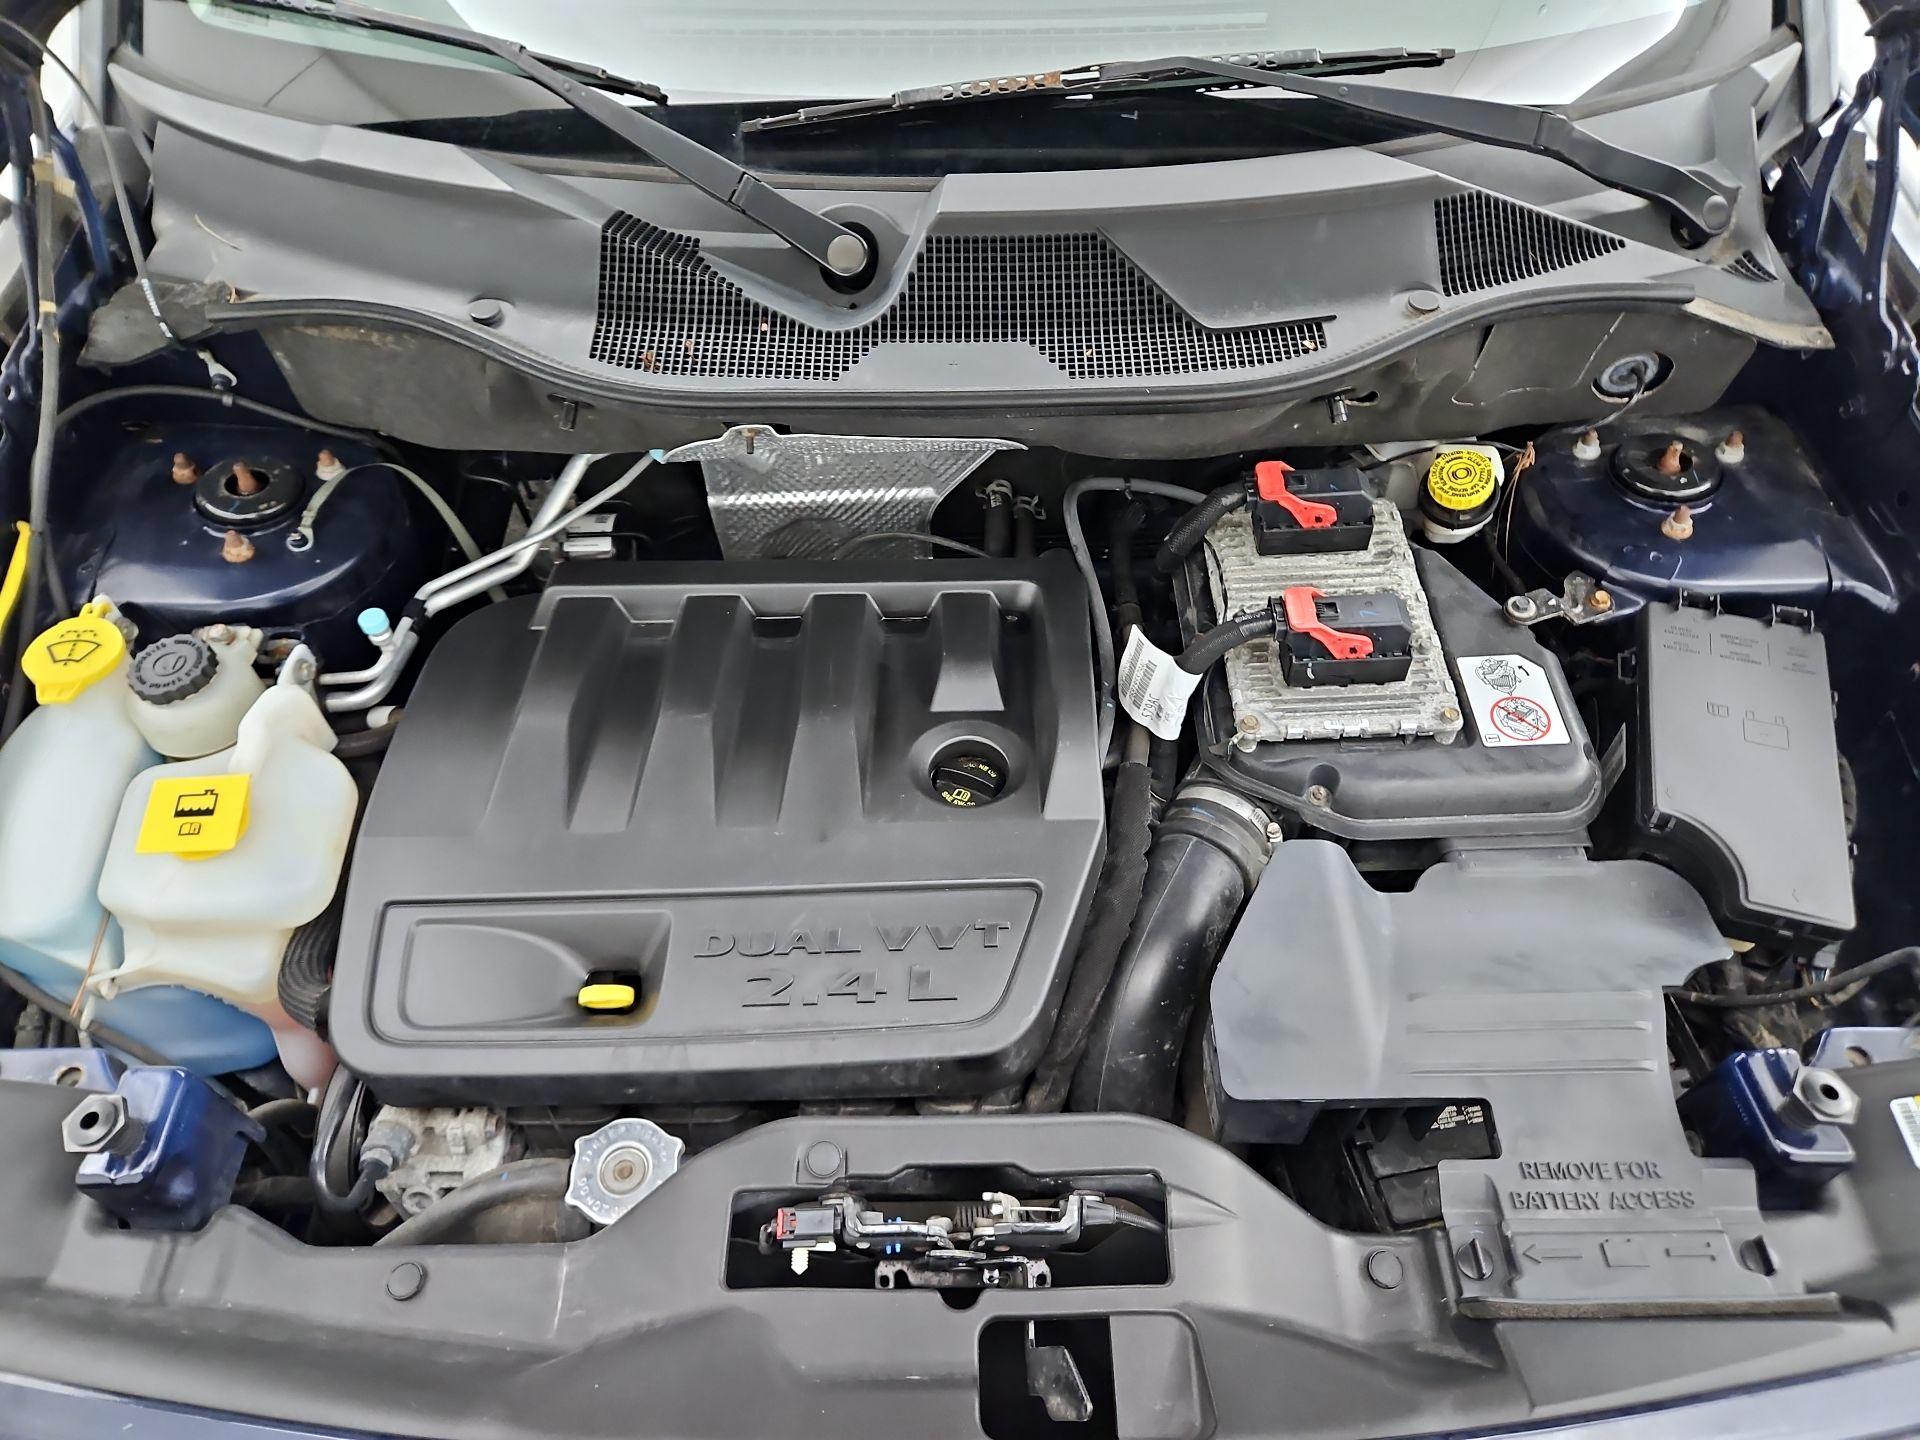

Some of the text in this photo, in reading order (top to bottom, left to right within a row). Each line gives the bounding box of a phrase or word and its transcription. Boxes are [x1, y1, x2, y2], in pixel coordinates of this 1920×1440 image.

[694, 919, 1010, 958] DUAL VVT
[1518, 1160, 1662, 1181] REMOVE FOR
[1509, 1189, 1696, 1211] BATTERY ACCESS
